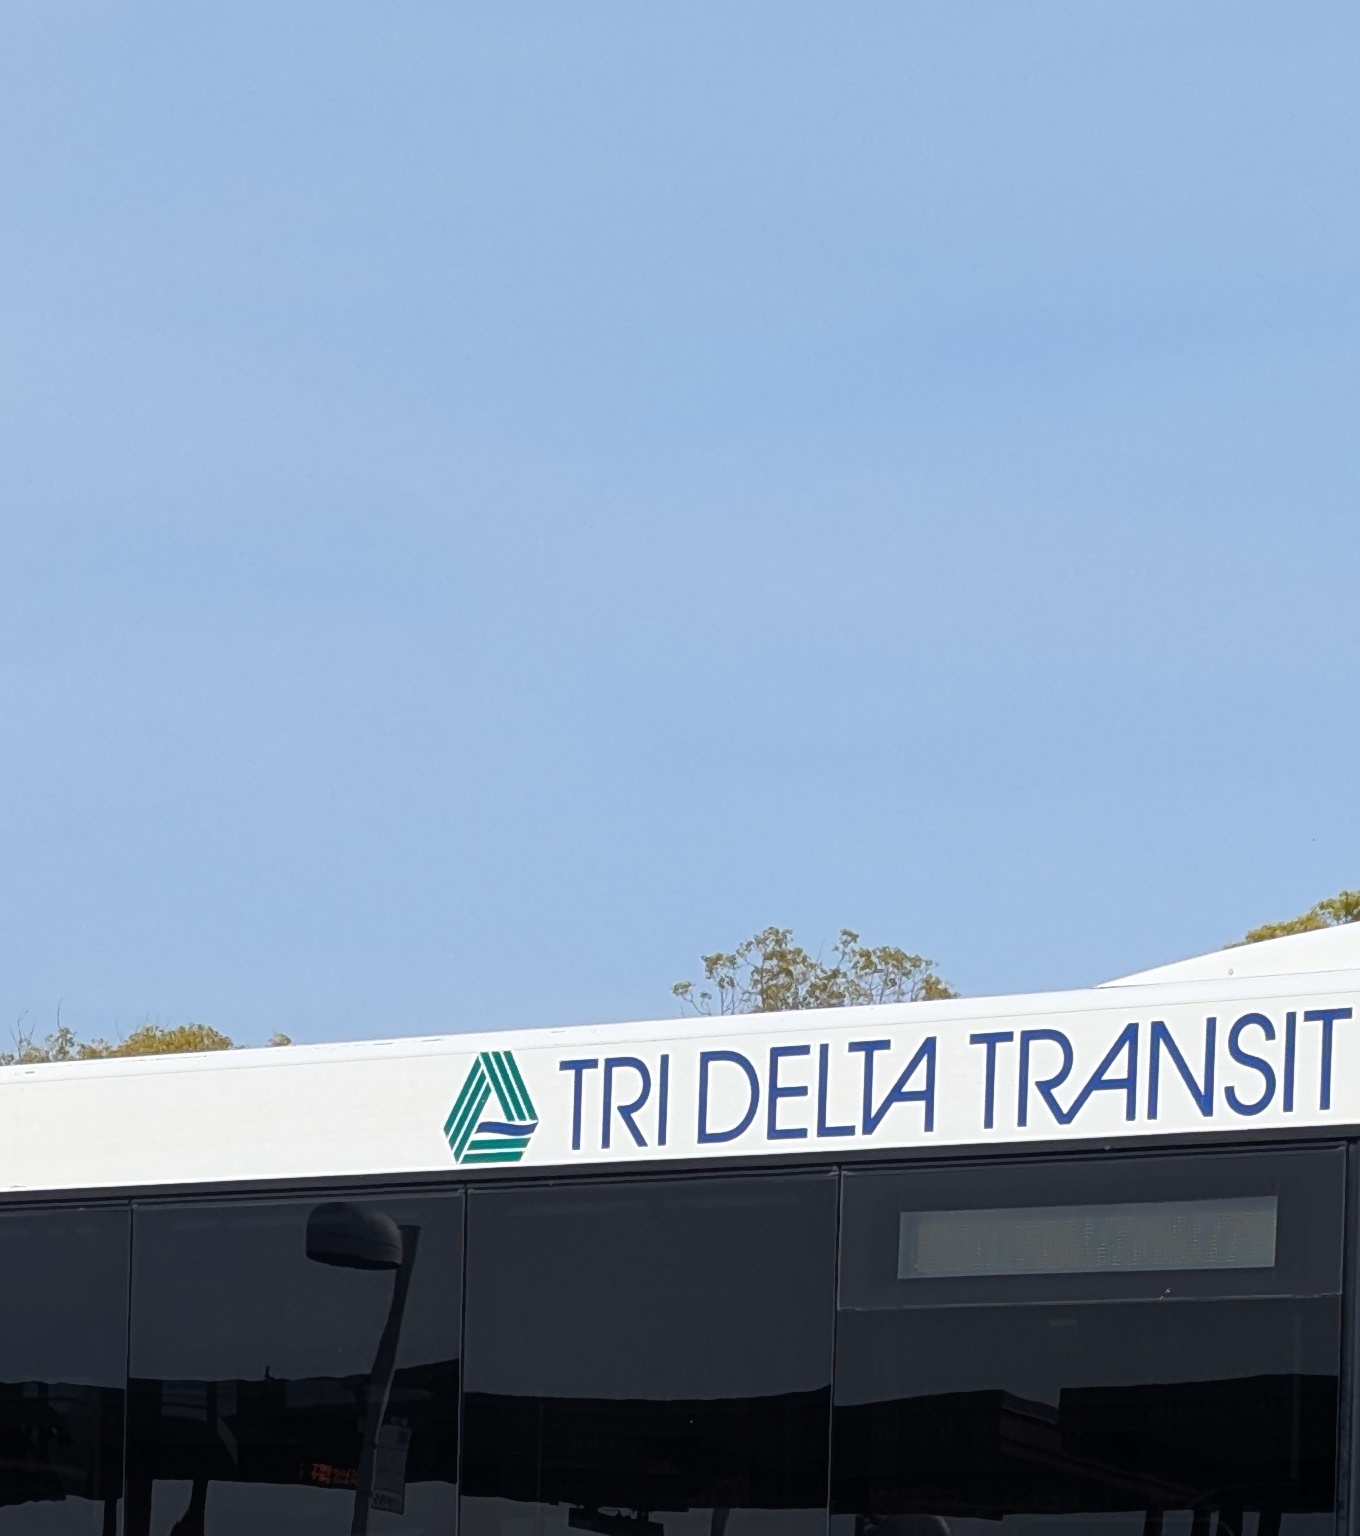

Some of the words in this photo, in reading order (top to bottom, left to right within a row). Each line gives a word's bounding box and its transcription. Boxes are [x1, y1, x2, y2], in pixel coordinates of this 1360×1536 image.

[559, 1053, 670, 1151] TRI
[697, 1036, 938, 1145] DELTA
[969, 1006, 1353, 1130] TRANSIT
